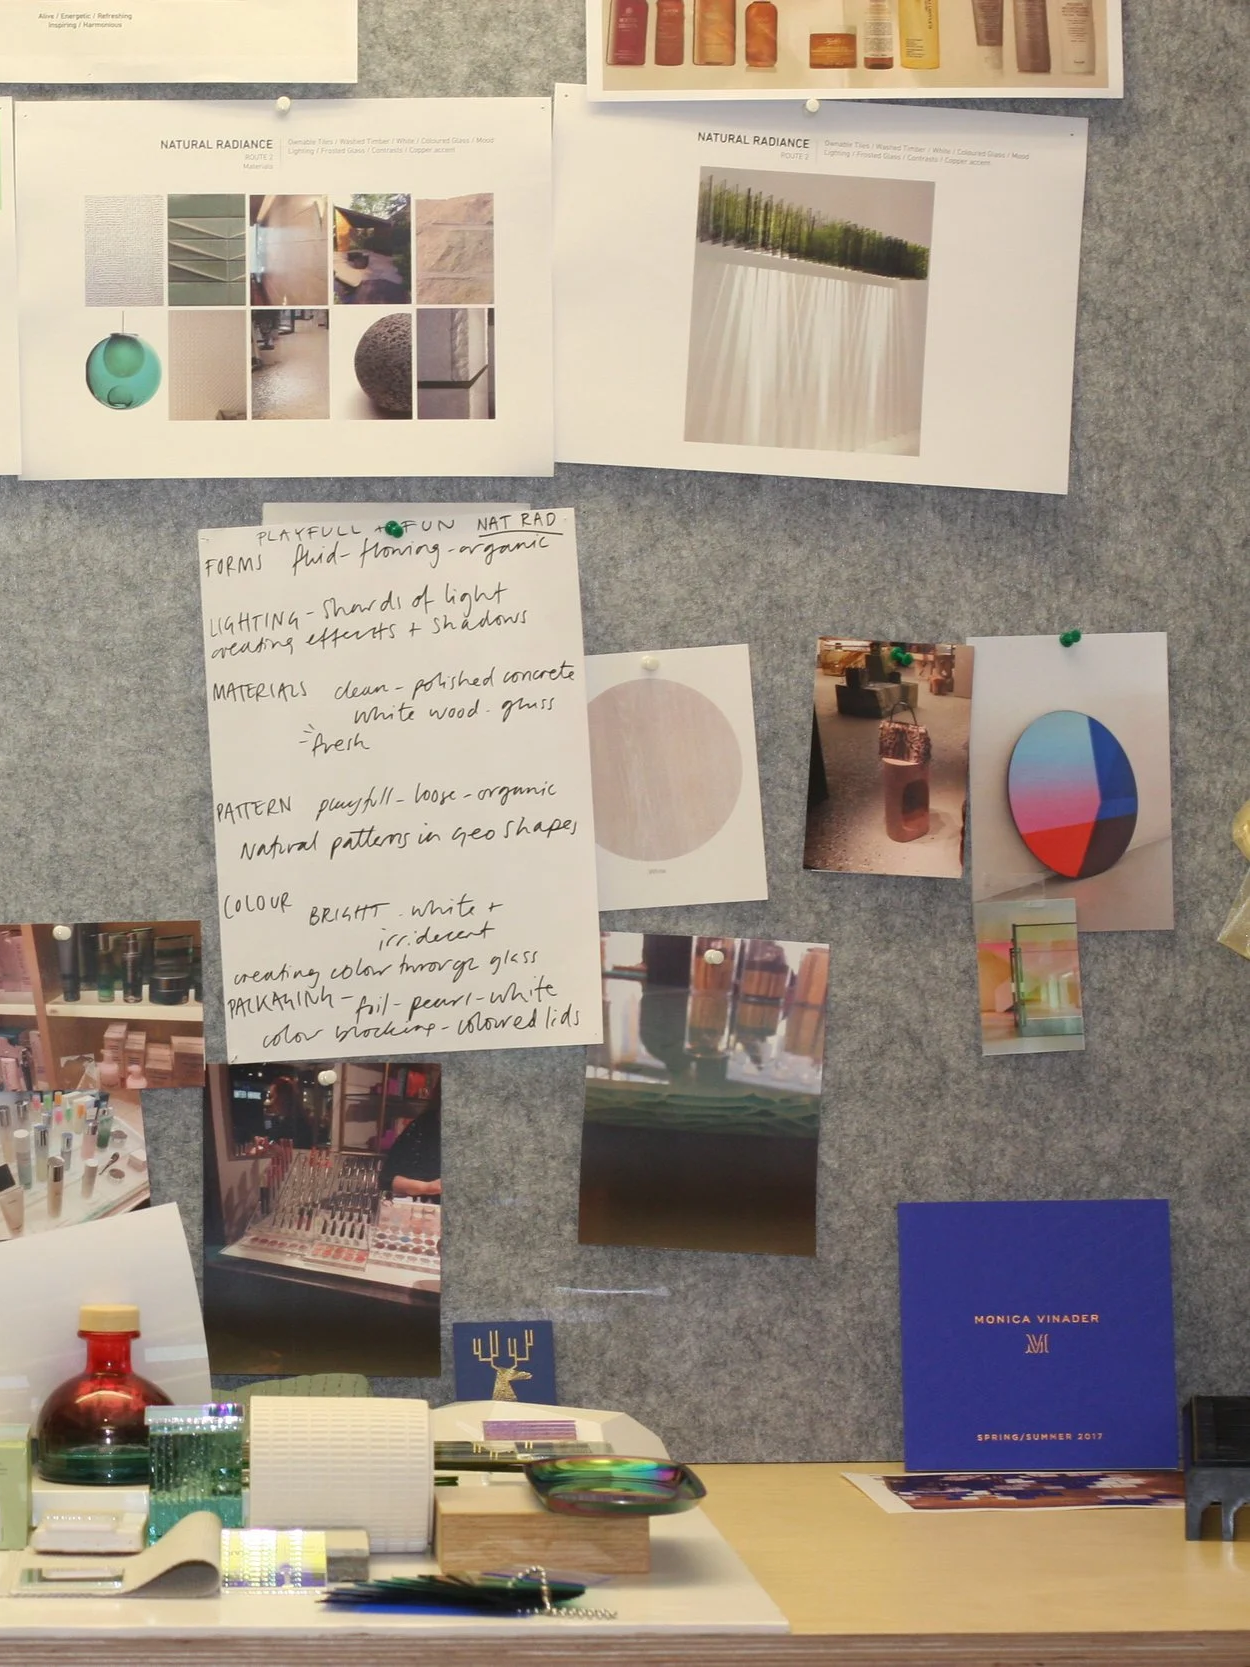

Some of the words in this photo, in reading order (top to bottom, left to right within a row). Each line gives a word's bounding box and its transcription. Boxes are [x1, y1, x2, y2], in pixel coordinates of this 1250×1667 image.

[160, 139, 213, 150] NATURAL
[216, 139, 273, 149] RADIANCE
[697, 132, 750, 145] NATURAL
[753, 135, 810, 149] RADIANCE
[258, 522, 361, 546] PLAYFULL
[402, 518, 455, 534] FUN
[477, 514, 510, 533] NAT
[520, 512, 557, 528] RAD
[205, 554, 263, 576] FORMS
[210, 611, 300, 639] LIGHTING
[444, 581, 509, 612] light
[213, 682, 308, 702] MATERIALS
[502, 660, 575, 683] concrete
[354, 705, 415, 725] white
[216, 796, 293, 824] PATTERN
[240, 831, 318, 861] Natural
[330, 825, 410, 860] patterns
[417, 823, 442, 845] in
[224, 892, 293, 920] COLOUR
[309, 902, 391, 927] BRIGHT
[234, 963, 320, 988] creating
[490, 950, 539, 977] glass
[228, 986, 333, 1020] PACKAGING
[974, 1315, 1031, 1324] MONICA
[1037, 1314, 1100, 1324] VINADER
[976, 1432, 1073, 1442] SPRING/SUMMER
[1078, 1432, 1103, 1441] 2017
